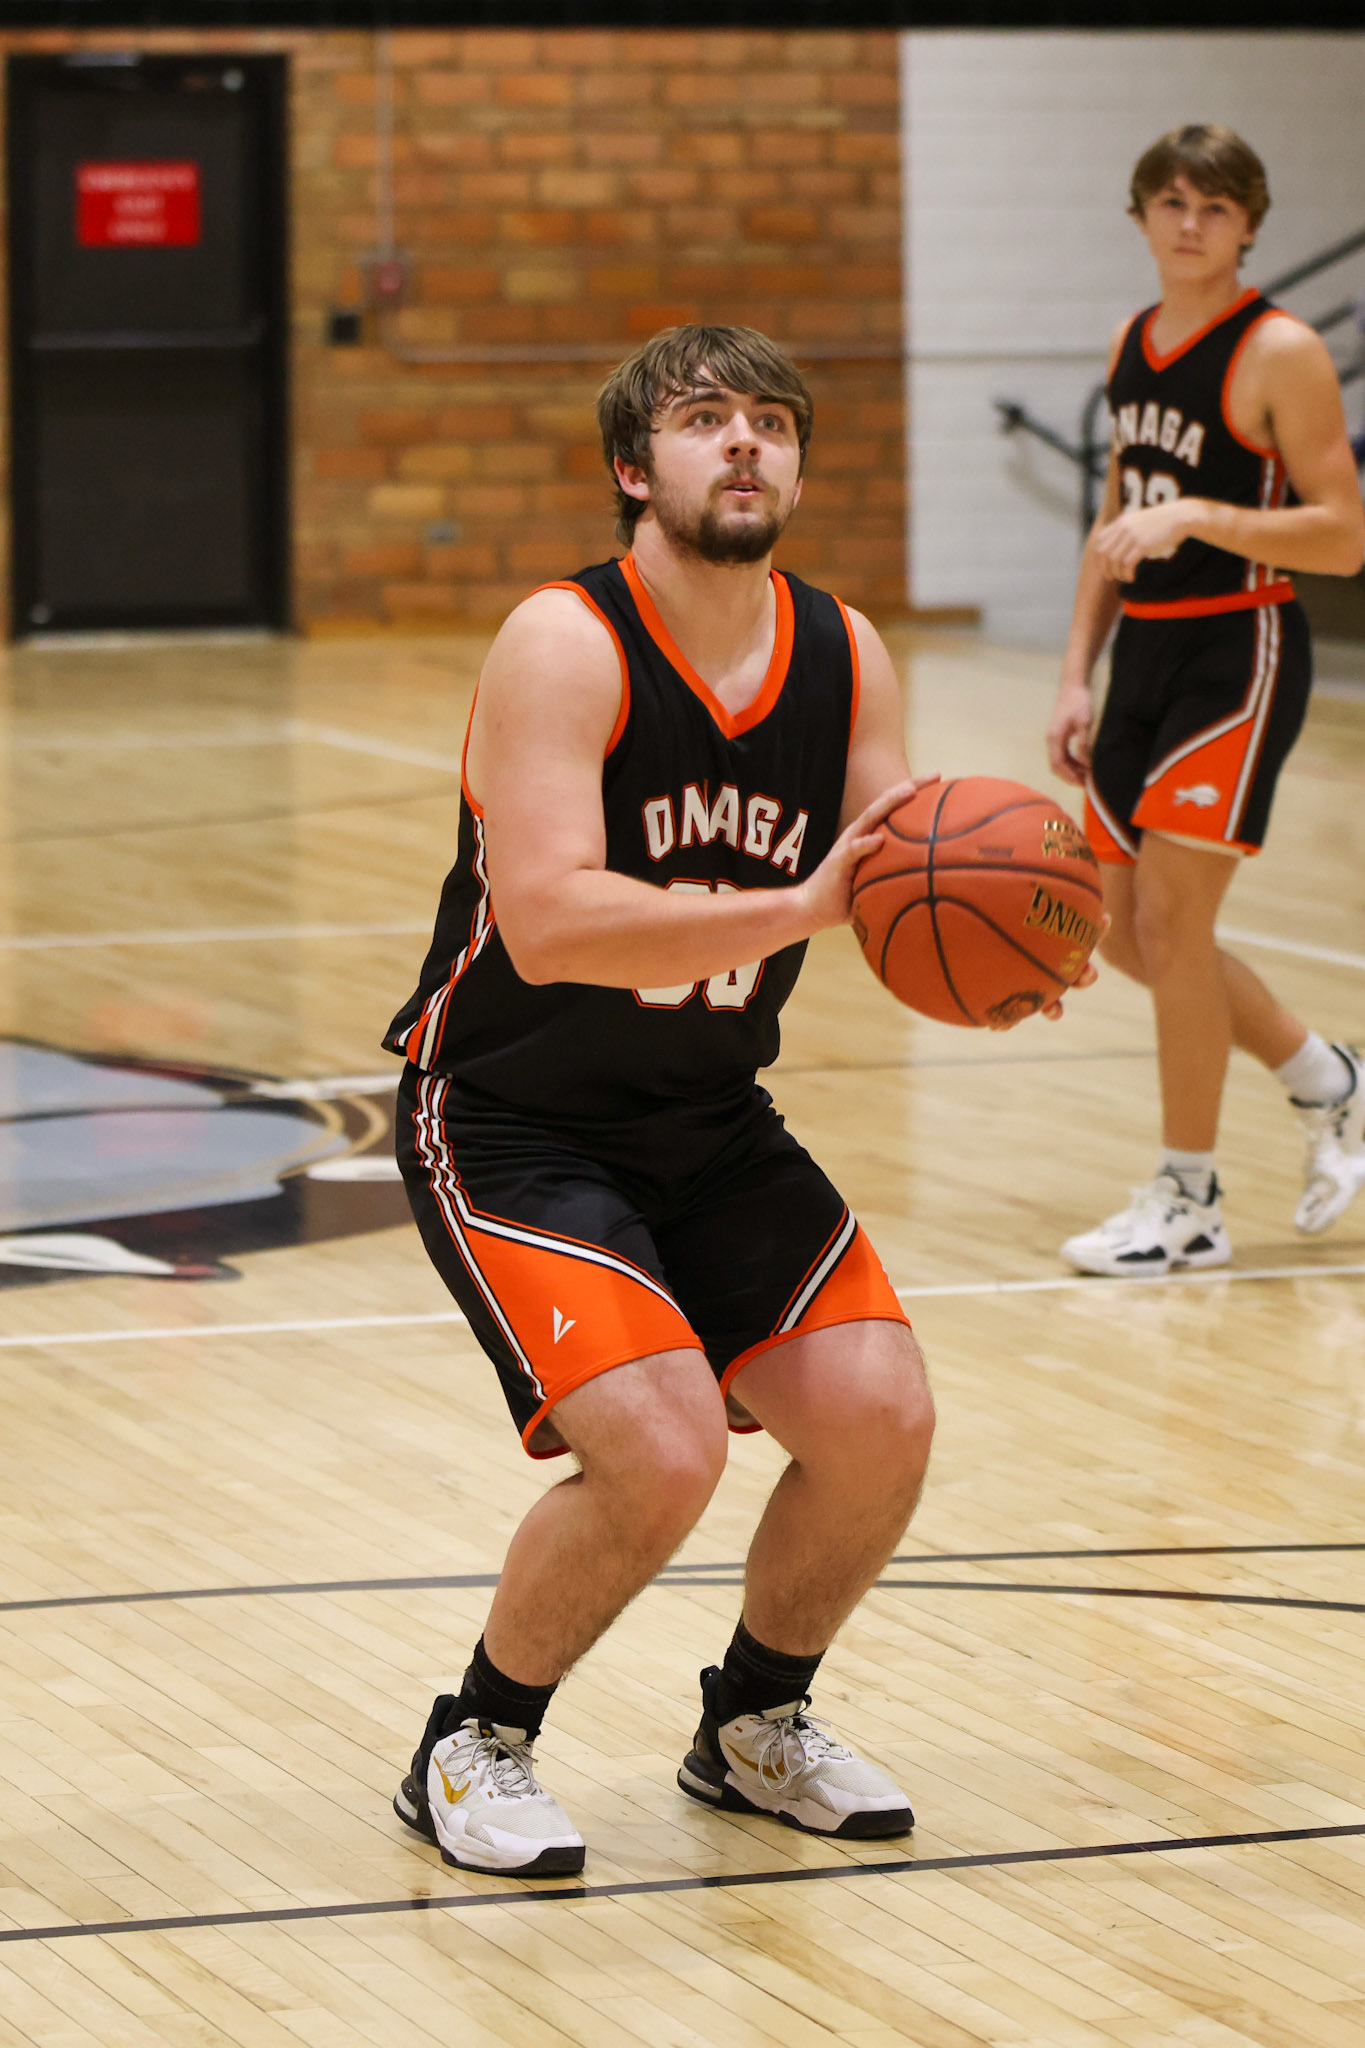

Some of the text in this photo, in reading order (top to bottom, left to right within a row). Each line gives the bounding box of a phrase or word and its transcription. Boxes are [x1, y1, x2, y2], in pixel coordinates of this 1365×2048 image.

[1113, 402, 1205, 468] NAGA
[641, 780, 809, 877] ONAGA
[1023, 884, 1098, 947] LDING
